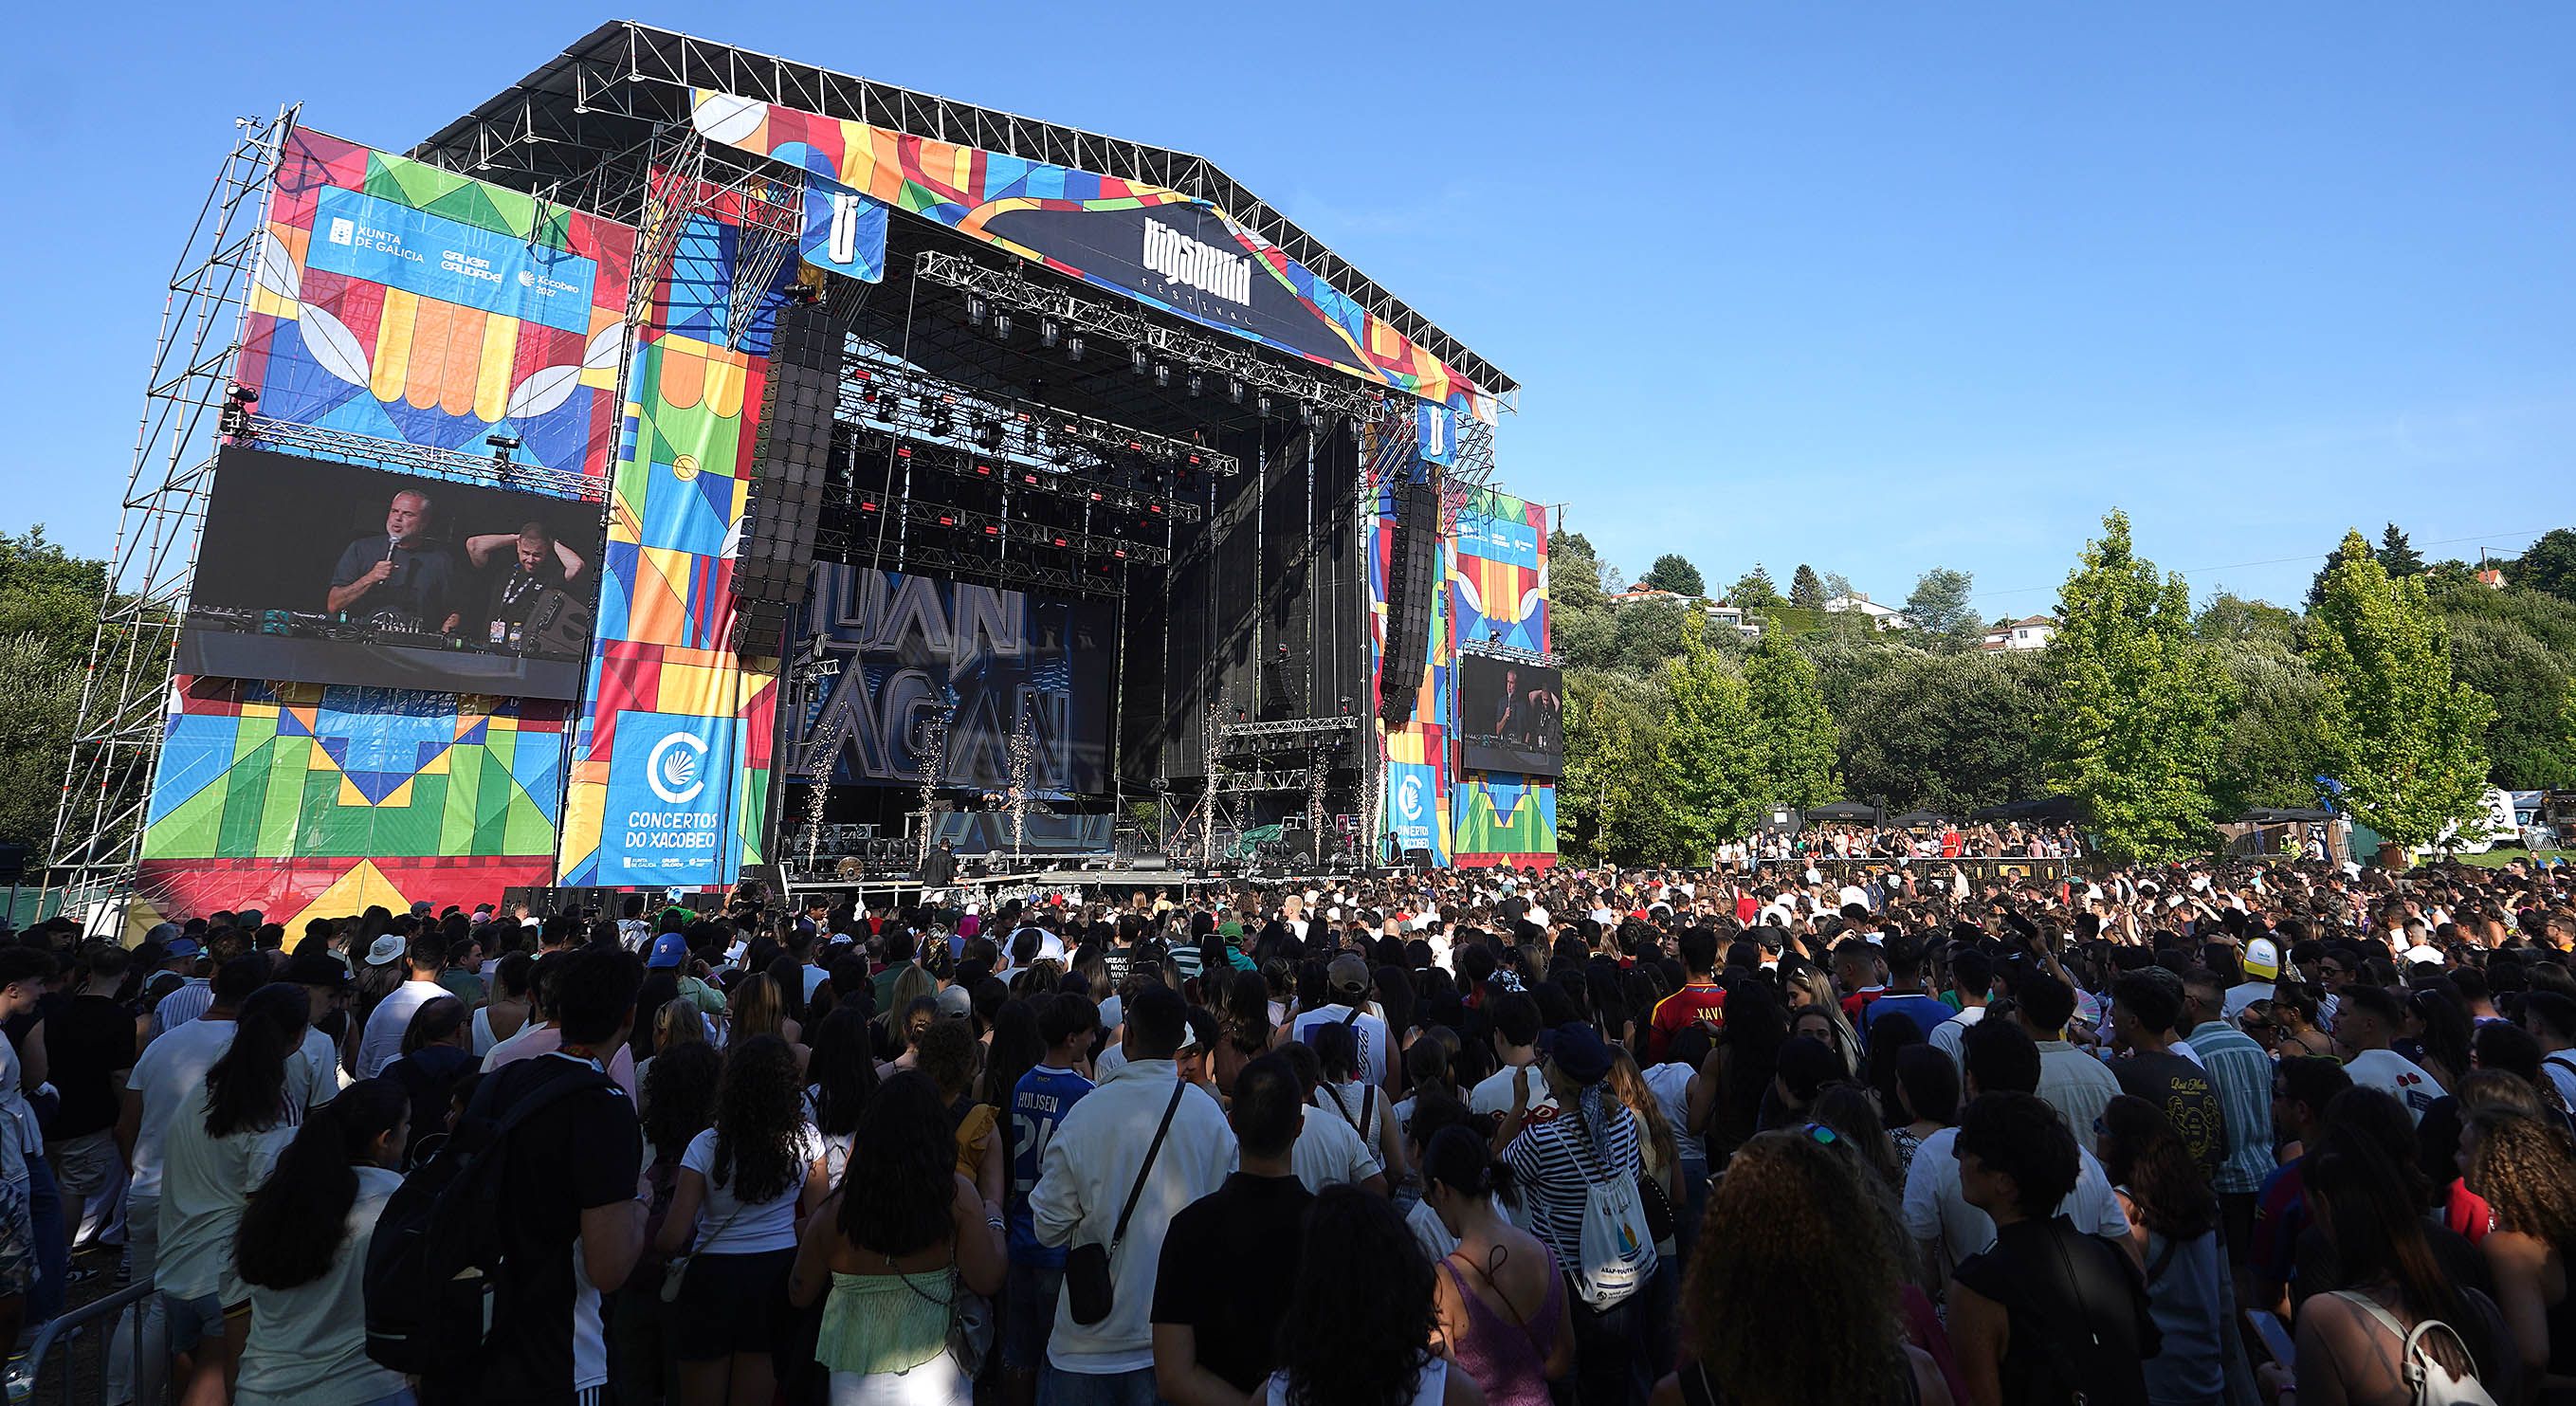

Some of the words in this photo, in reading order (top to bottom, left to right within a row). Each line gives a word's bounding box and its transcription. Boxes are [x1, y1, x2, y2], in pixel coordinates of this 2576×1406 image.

[356, 226, 401, 245] XUNTA
[355, 236, 374, 249] DE
[375, 241, 425, 265] GALICIA
[536, 286, 557, 298] 2027
[1142, 277, 1252, 325] FESTIVAL
[629, 811, 718, 829] CONCERTOS
[625, 831, 648, 849] DO
[649, 831, 716, 849] XACOBEO
[1696, 1006, 1723, 1020] XAVI
[1358, 1026, 1371, 1084] ngeles
[1017, 1091, 1059, 1113] HUIJSEN
